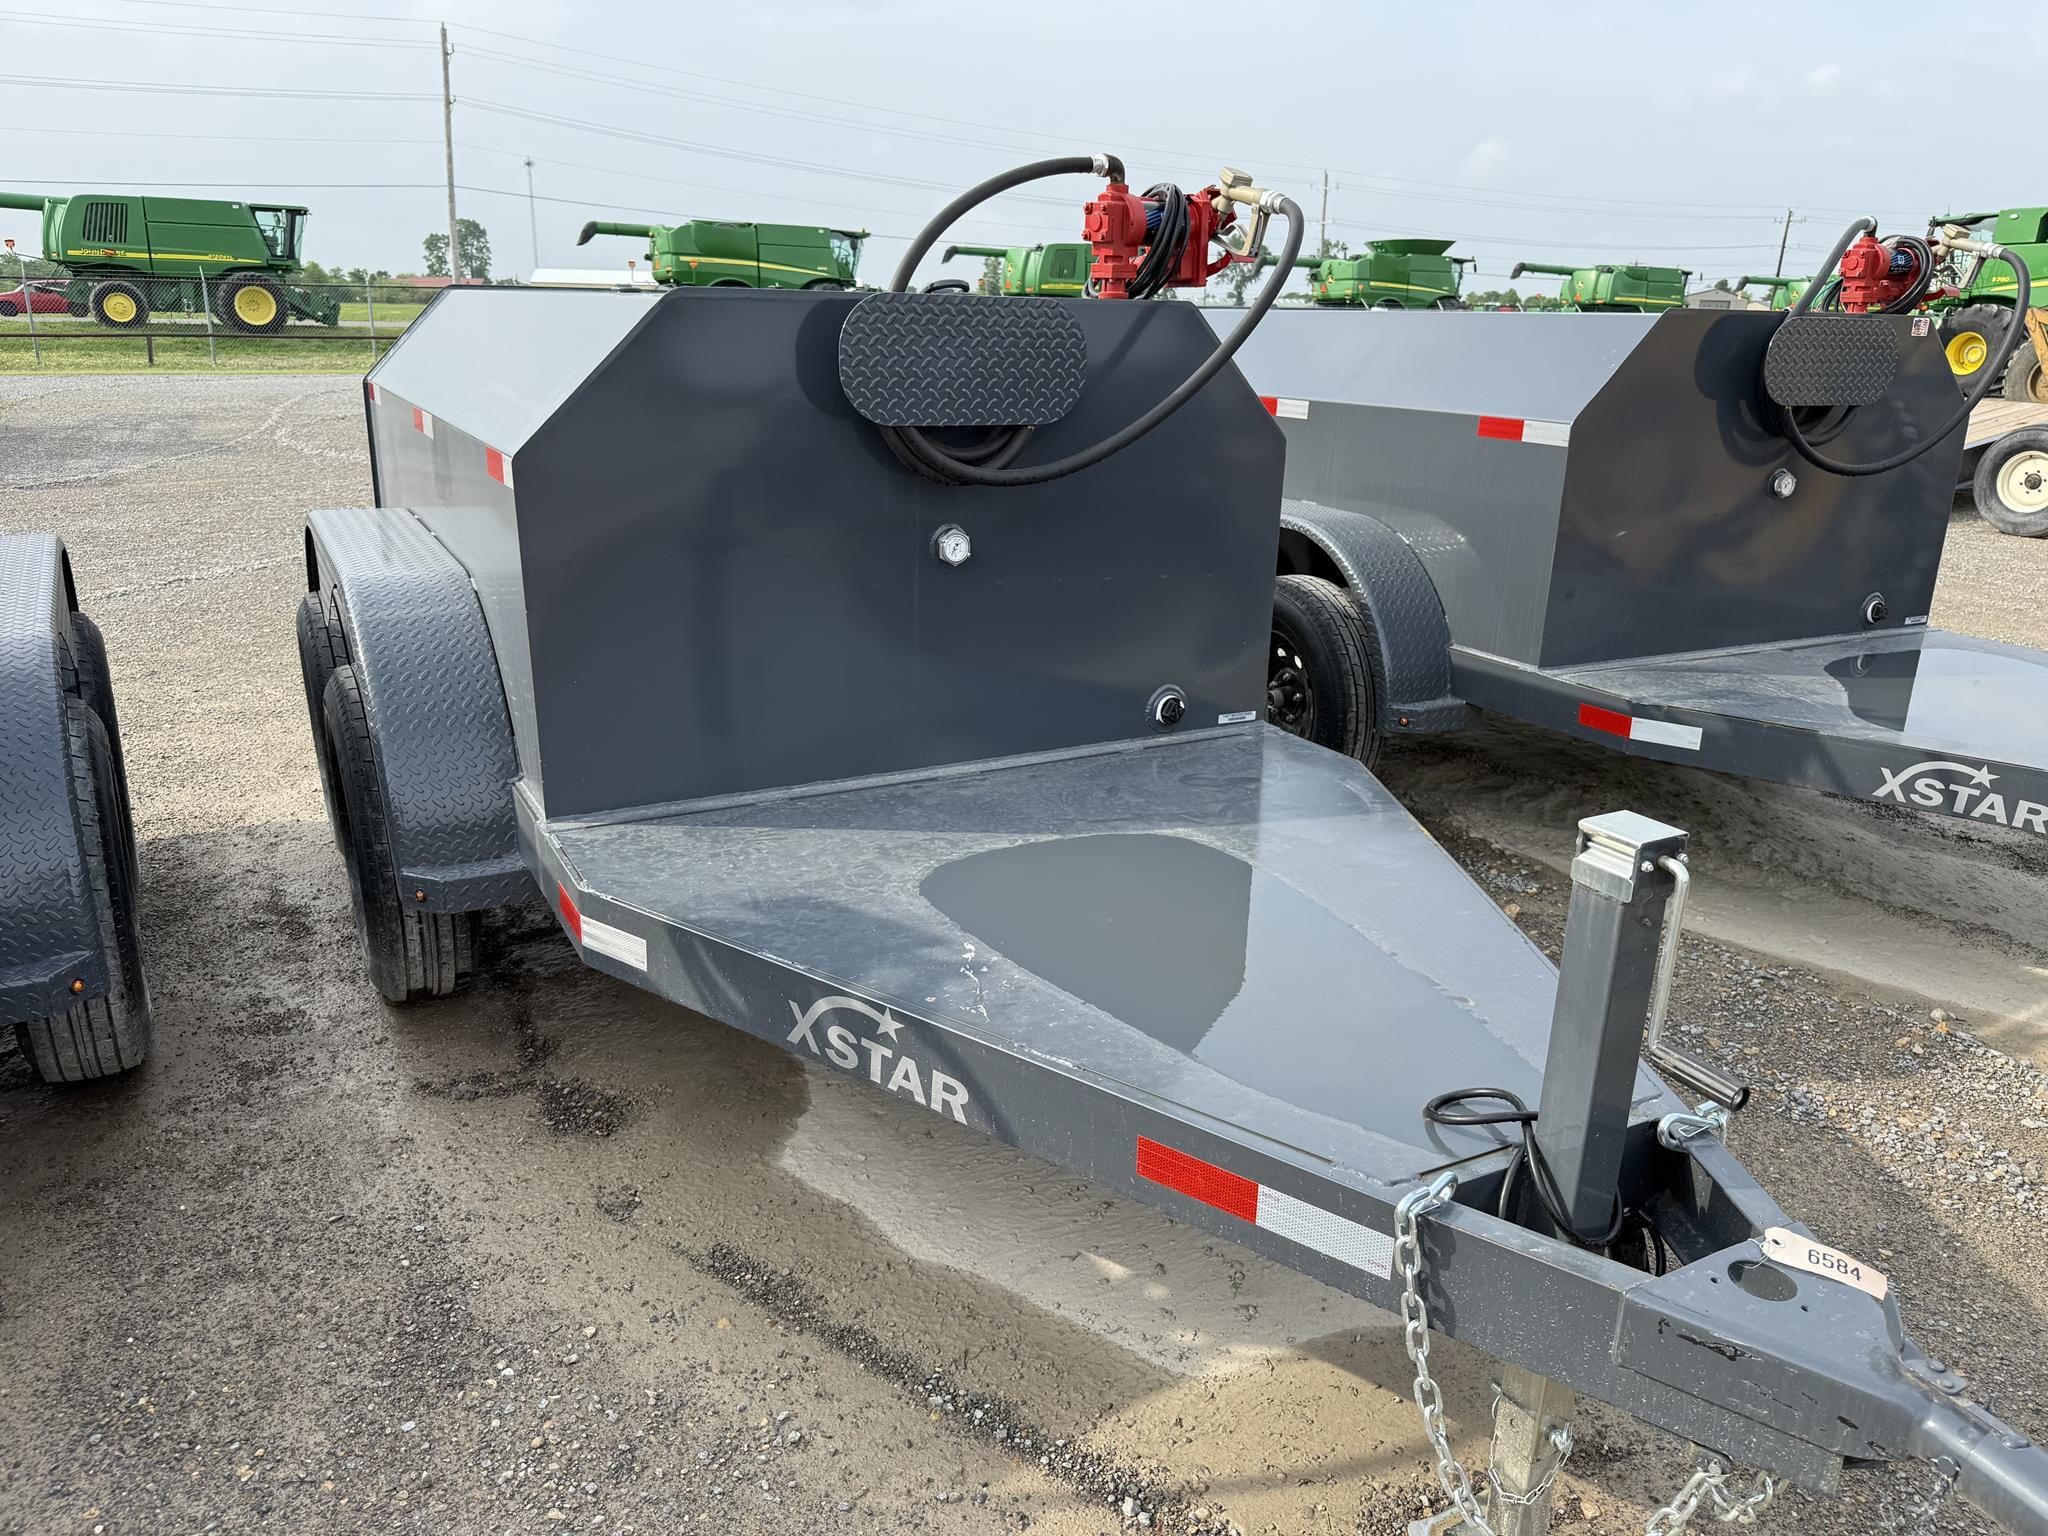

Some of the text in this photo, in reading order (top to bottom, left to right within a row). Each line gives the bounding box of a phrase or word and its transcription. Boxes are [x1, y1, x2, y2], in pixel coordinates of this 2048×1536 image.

[1872, 761, 2048, 834] XSTAR
[786, 996, 969, 1126] XSTAR
[1808, 1249, 1862, 1282] 6584
